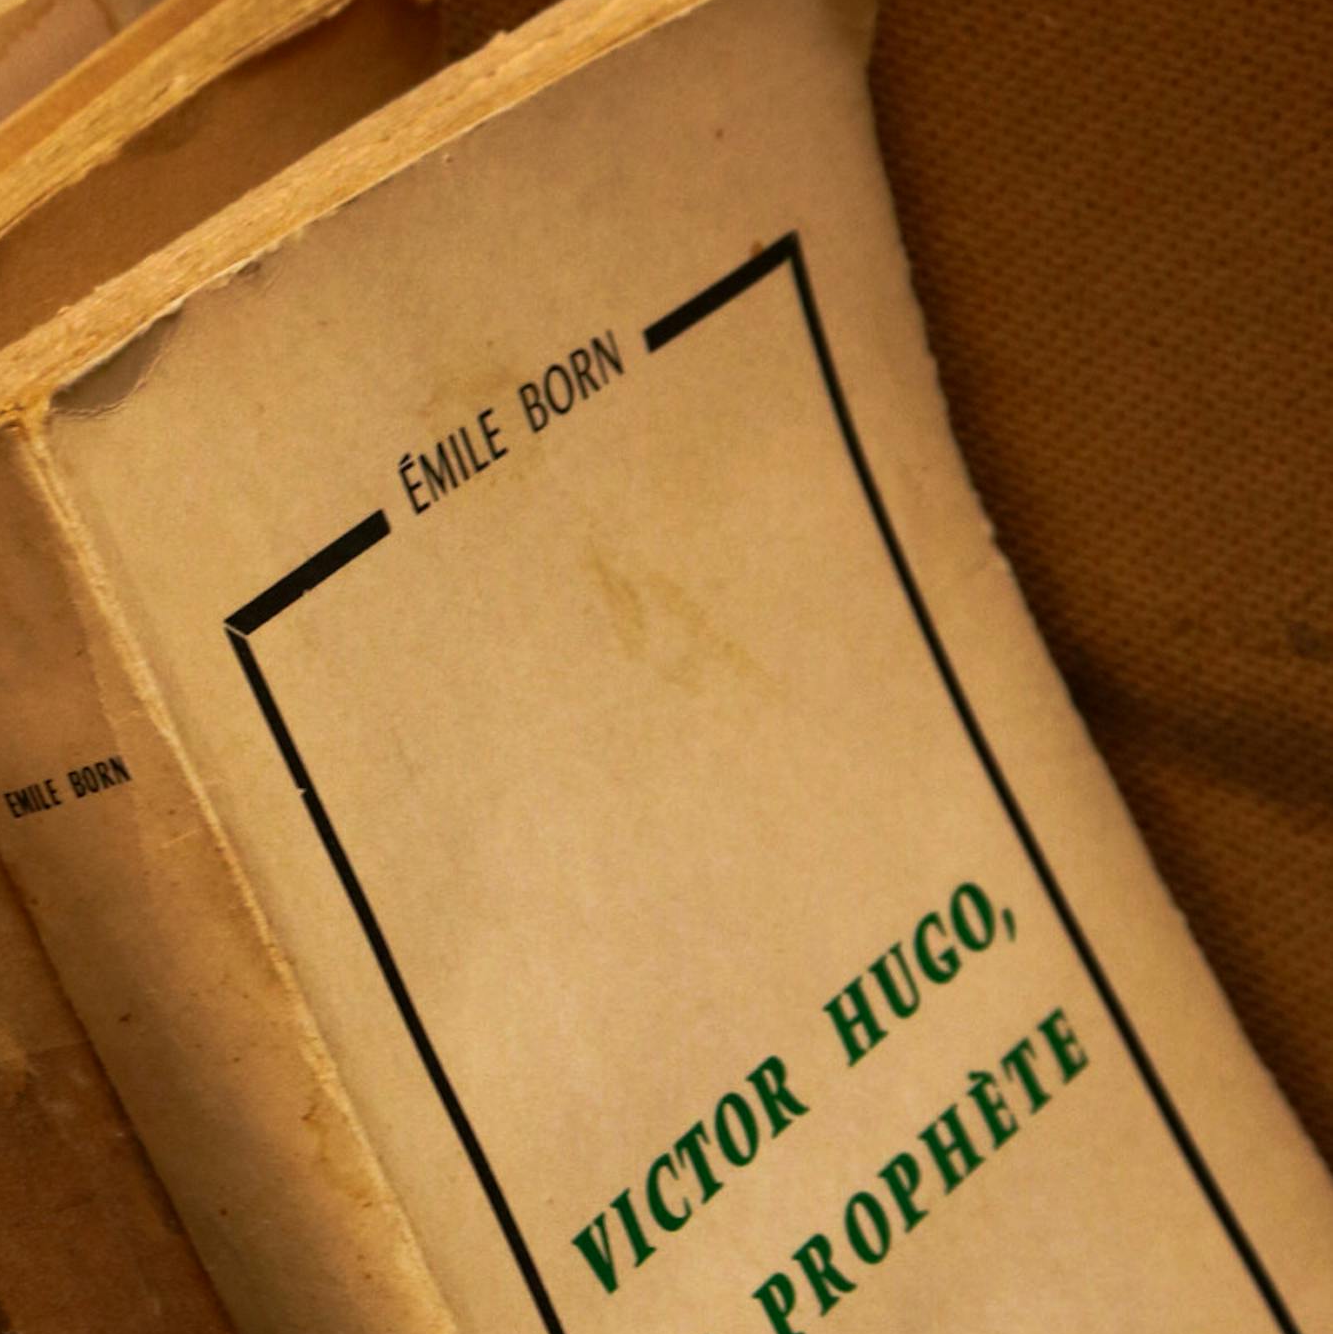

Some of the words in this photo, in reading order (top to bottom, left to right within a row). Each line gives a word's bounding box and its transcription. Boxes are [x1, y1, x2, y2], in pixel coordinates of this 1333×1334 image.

[399, 408, 510, 515] ÉMILE
[519, 329, 625, 433] BORN
[4, 779, 62, 818] EMILE
[68, 755, 132, 798] BORN
[571, 1055, 809, 1295] VICTOR
[823, 881, 1016, 1068] HUGO,
